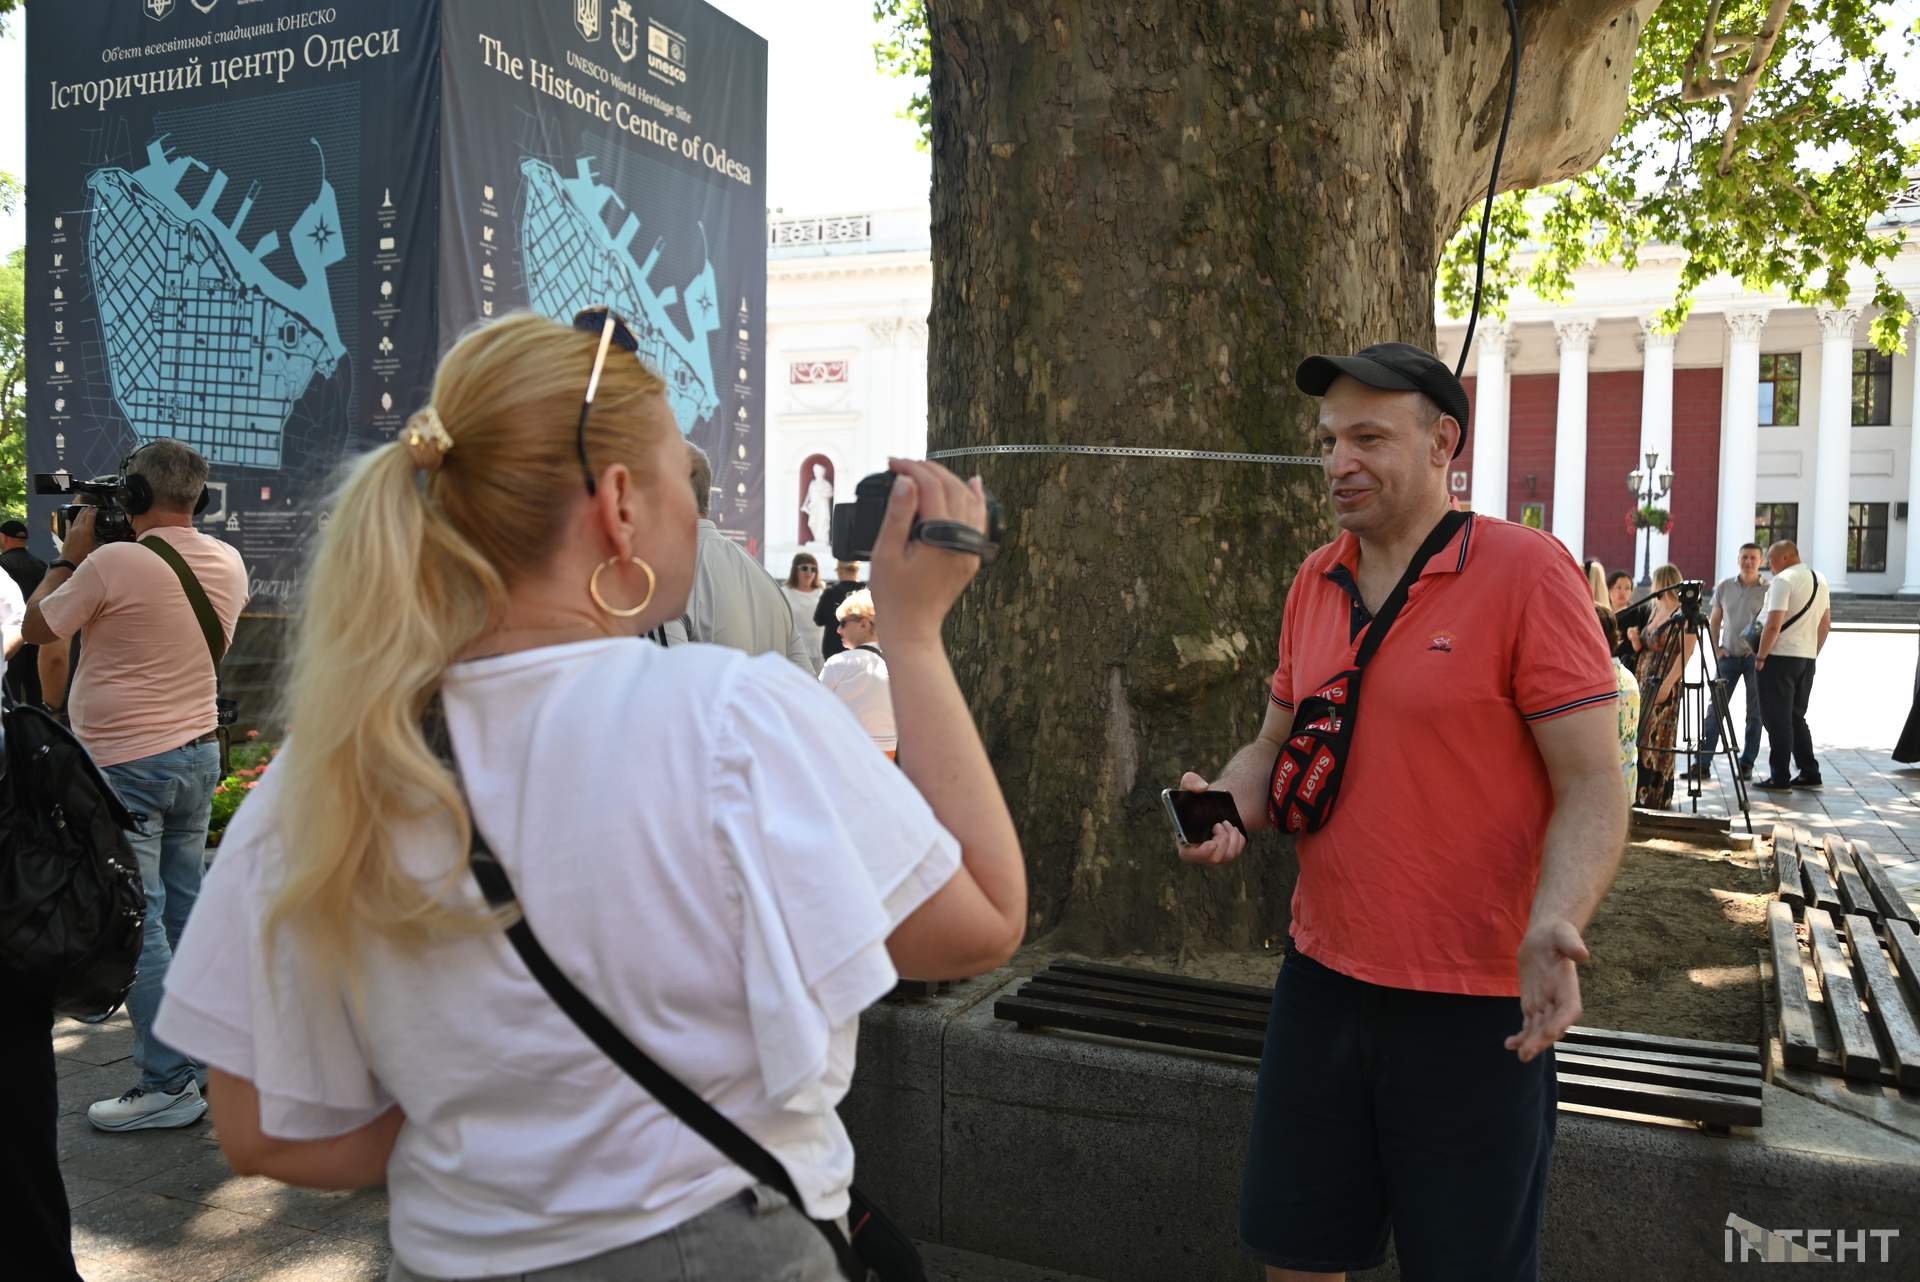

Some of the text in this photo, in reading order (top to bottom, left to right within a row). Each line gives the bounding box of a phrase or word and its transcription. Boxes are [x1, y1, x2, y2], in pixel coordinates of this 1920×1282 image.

[50, 28, 401, 111] Історичний центр Одеси
[102, 7, 337, 63] Об'єкт всесвітньої спадщини ЮНЕСКО
[647, 53, 687, 83] unesco
[478, 33, 752, 186] The Historic Centre of Odesa
[566, 50, 609, 83] UNESCO
[610, 73, 637, 99] World
[638, 87, 675, 117] Heritage
[675, 105, 693, 124] Site
